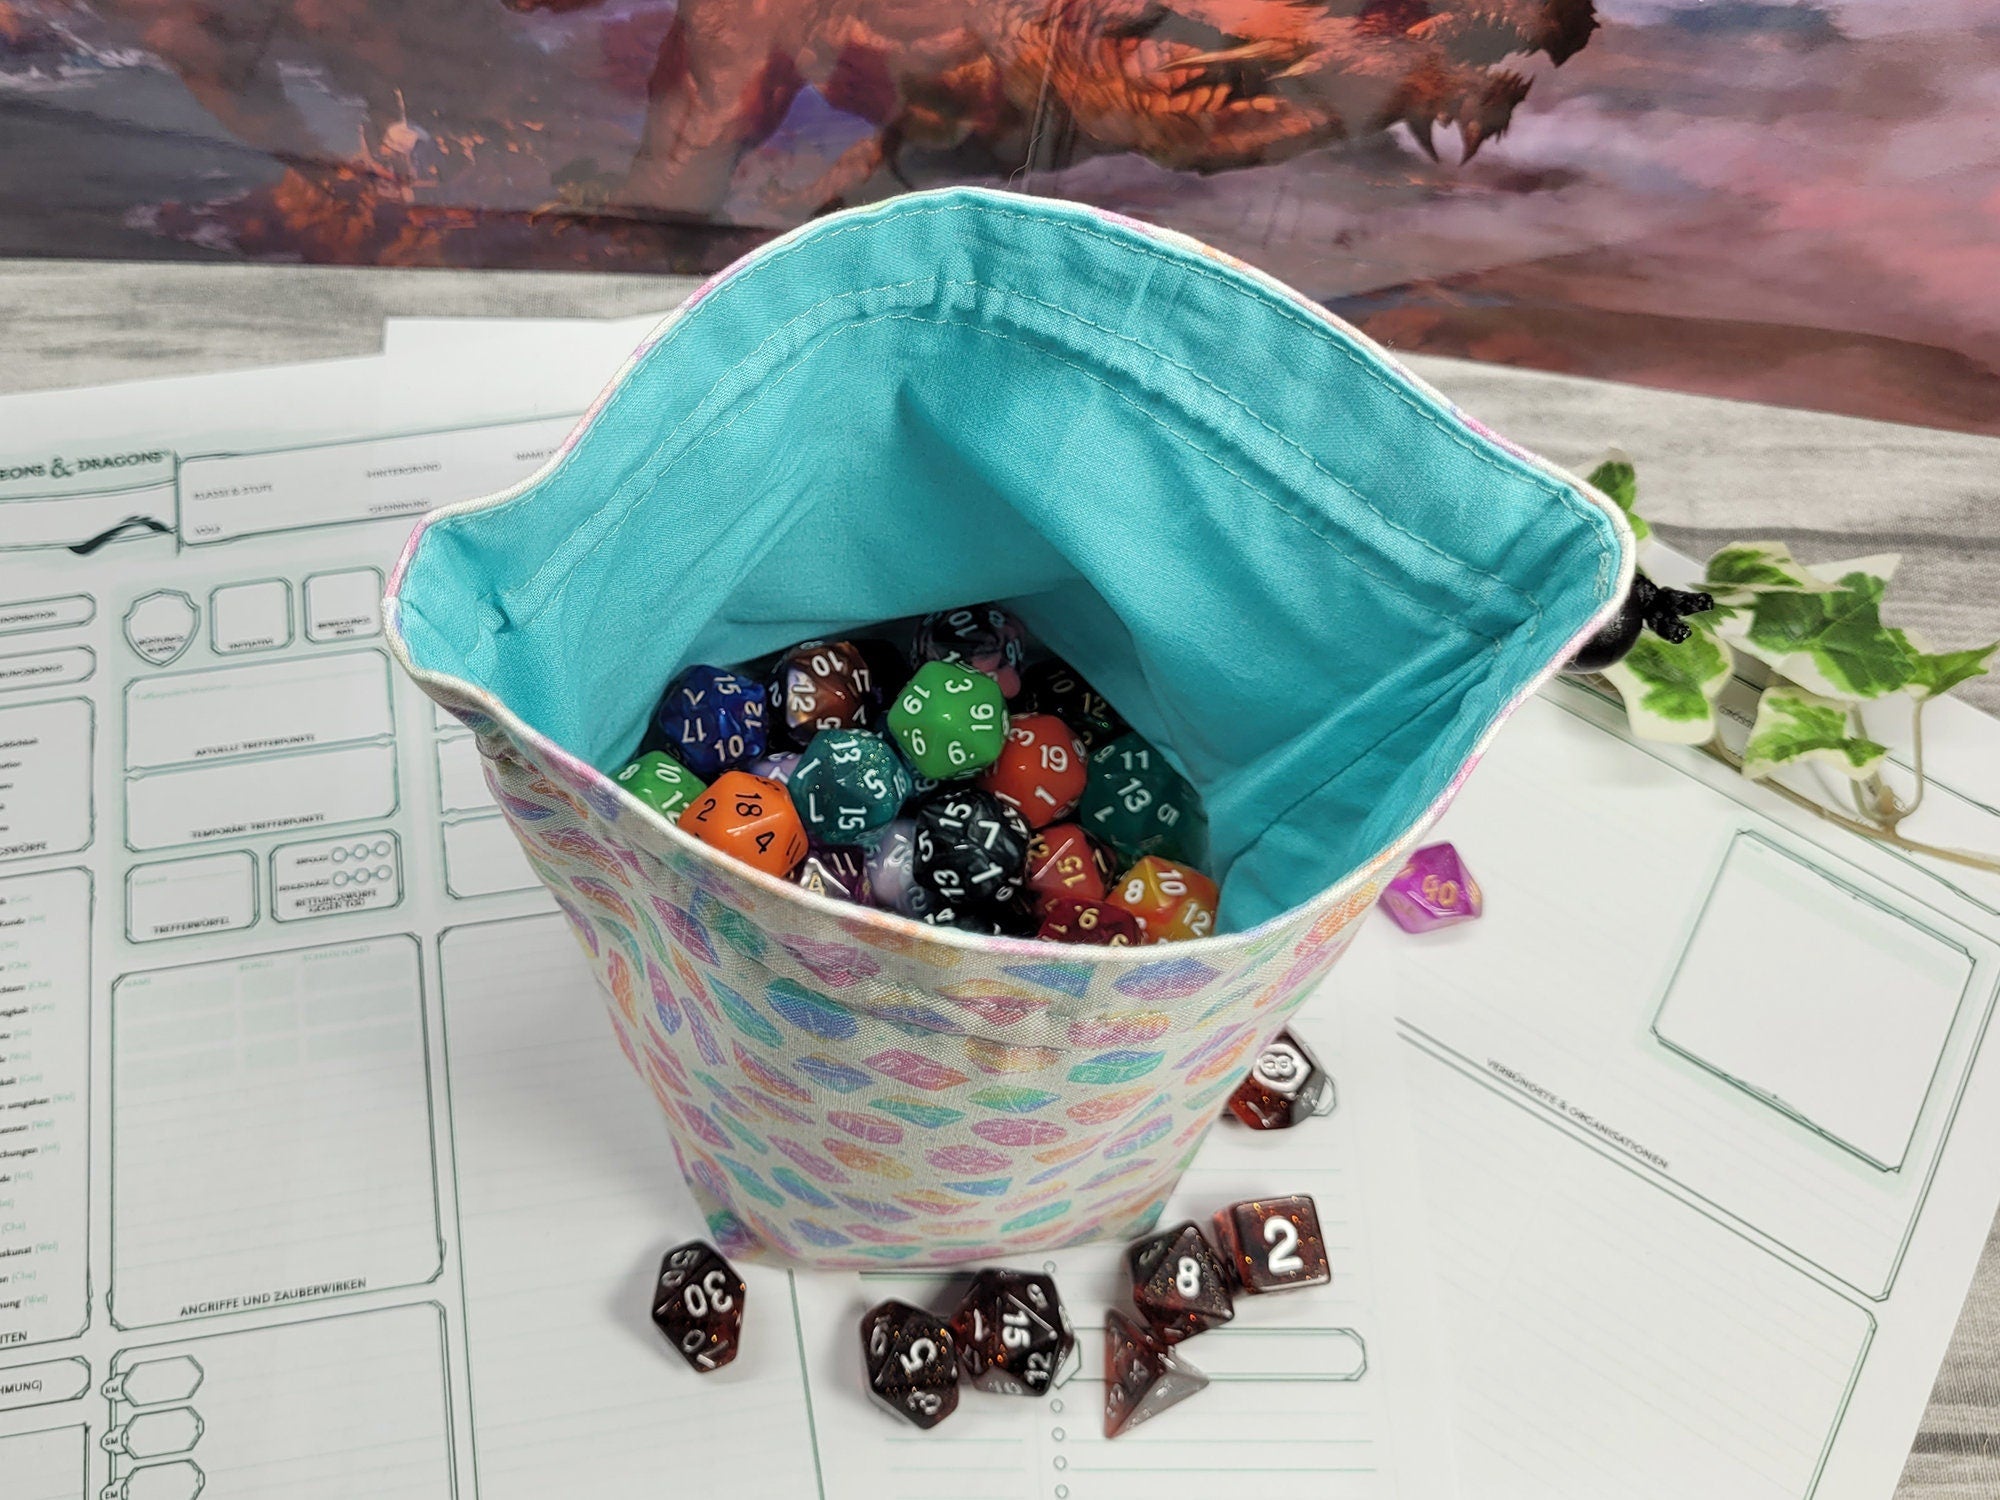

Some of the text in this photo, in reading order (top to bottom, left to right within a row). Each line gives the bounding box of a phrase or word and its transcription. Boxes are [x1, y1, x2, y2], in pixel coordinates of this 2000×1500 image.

[77, 450, 163, 471] DRAGONS
[811, 650, 844, 678] 10
[851, 668, 871, 693] 17
[944, 678, 974, 694] 3
[790, 685, 817, 713] 12
[744, 700, 763, 730] 12
[713, 734, 745, 762] 10
[828, 738, 862, 764] 13
[1039, 743, 1069, 774] 19
[1119, 749, 1150, 771] 11
[654, 761, 683, 784] 10
[862, 768, 888, 800] 5
[734, 792, 763, 817] 18
[1116, 777, 1153, 814] 13
[696, 797, 717, 823] 2
[837, 805, 868, 830] 15
[938, 801, 973, 829] 15
[755, 830, 775, 855] 4
[918, 829, 934, 863] 5
[977, 820, 1001, 851] 7
[932, 868, 966, 898] 13
[970, 861, 1004, 885] 1
[1156, 869, 1189, 897] 10
[1123, 878, 1145, 905] 8
[1181, 902, 1212, 938] 12
[1264, 1216, 1304, 1276] 2
[1176, 1256, 1200, 1299] 8
[180, 1277, 367, 1317] ANGRIFFE UND ZAUBERWIRKEN
[682, 1269, 734, 1319] 30
[900, 1336, 938, 1372] 5
